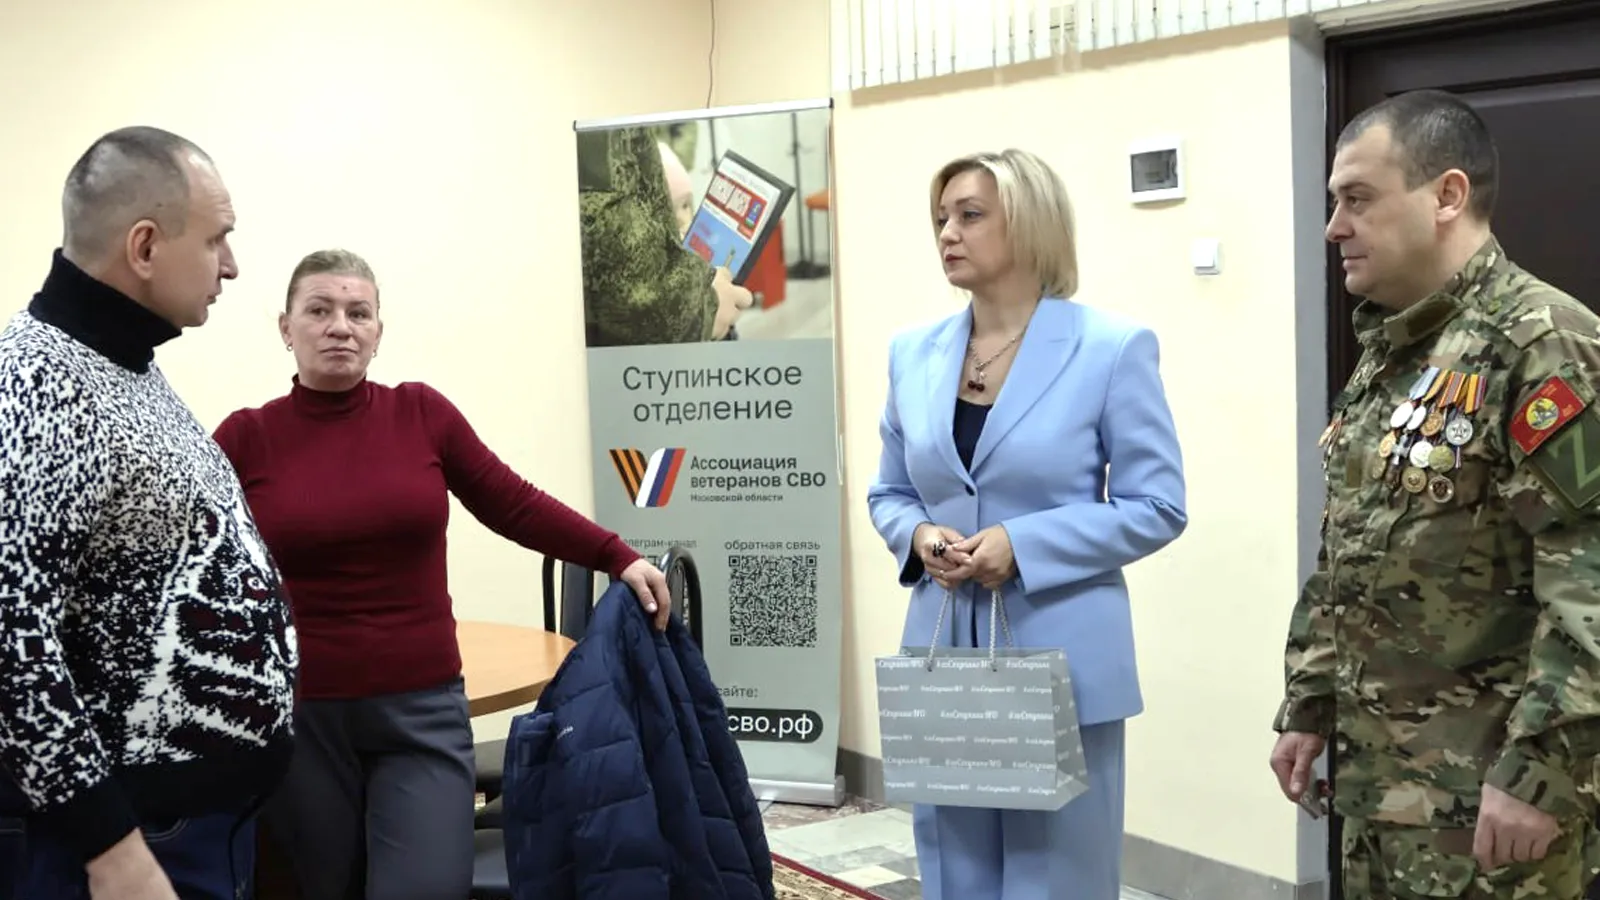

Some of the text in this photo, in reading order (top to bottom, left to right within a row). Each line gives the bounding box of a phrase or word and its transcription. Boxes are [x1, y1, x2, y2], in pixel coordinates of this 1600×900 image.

[623, 366, 802, 396] Ступинское
[633, 399, 793, 425] отделение
[690, 456, 797, 471] Ассоциация
[691, 472, 826, 490] ветеранов СВО
[745, 493, 783, 502] области
[624, 538, 697, 549] елеграм-канал
[724, 540, 821, 551] обратная связь
